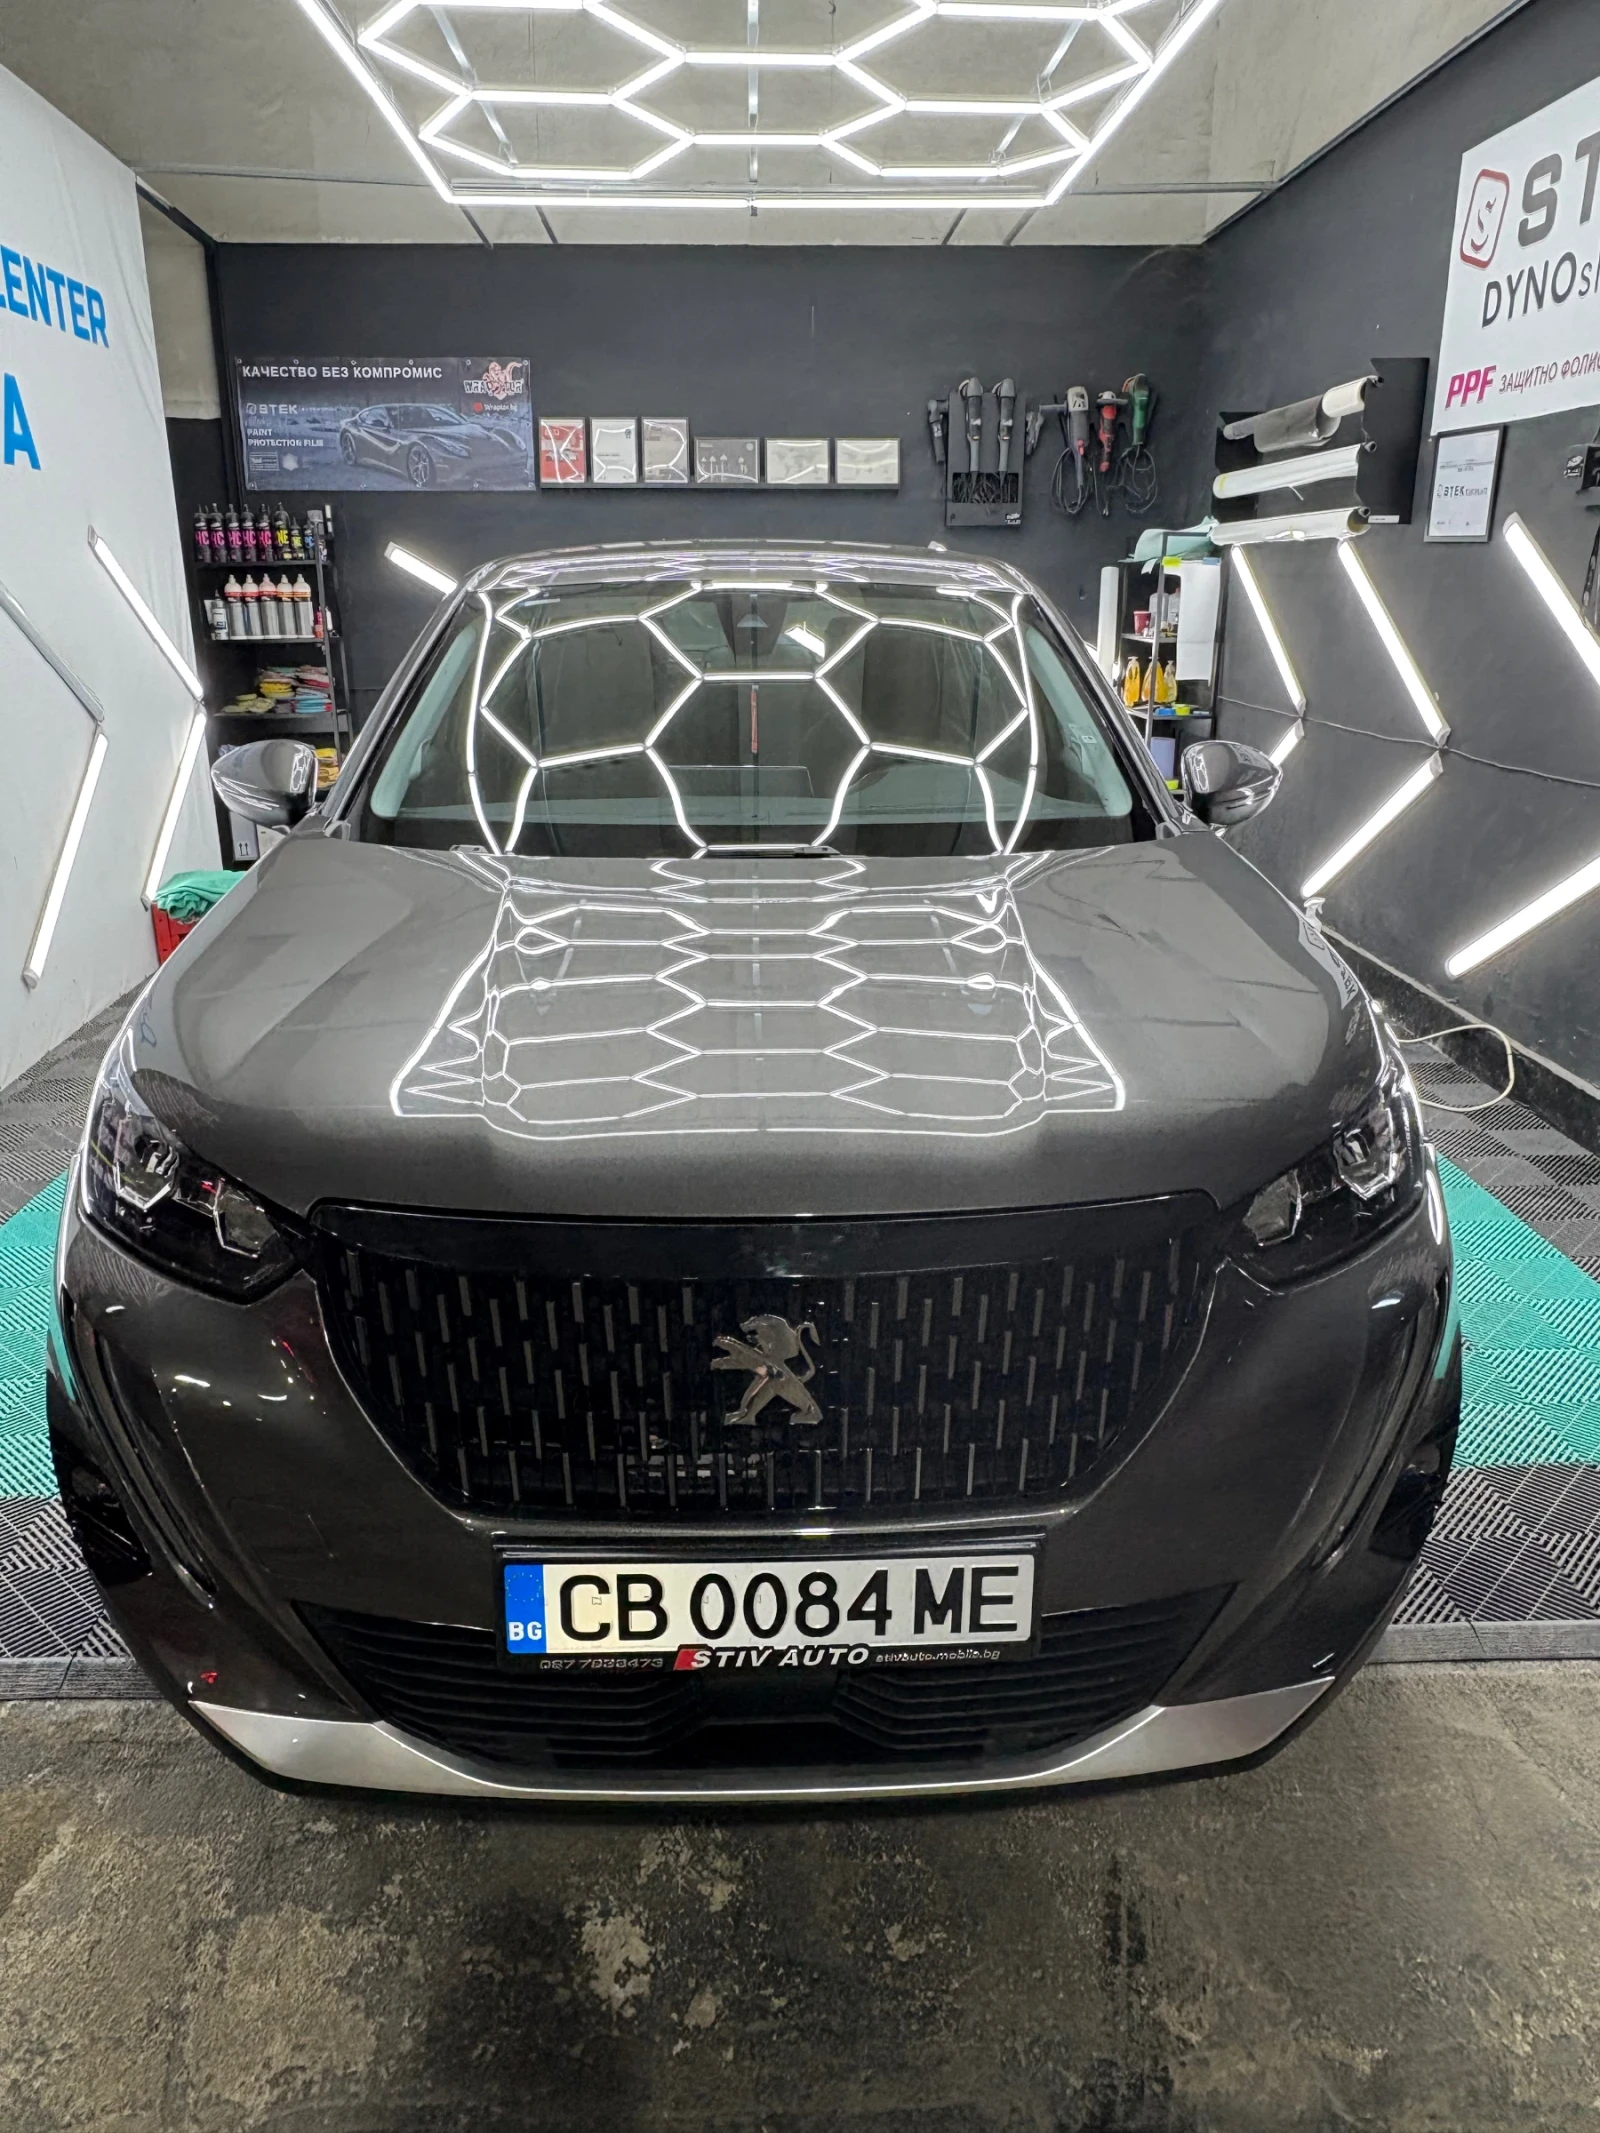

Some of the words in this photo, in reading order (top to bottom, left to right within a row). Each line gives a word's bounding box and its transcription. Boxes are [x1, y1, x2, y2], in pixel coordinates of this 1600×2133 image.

[0, 243, 109, 349] ENTER
[242, 365, 318, 378] КАЧЕСТВО
[322, 366, 349, 378] БЕЗ
[353, 367, 442, 379] КОМПРОМИС
[1445, 365, 1497, 410] PPF
[1499, 361, 1558, 394] ЗАЩИТНО
[259, 404, 298, 415] STEK
[247, 428, 273, 437] PAINT
[248, 438, 302, 447] PROTECTION
[303, 439, 324, 447] FILM
[558, 1572, 668, 1642] CB
[689, 1570, 893, 1641] 0084
[913, 1565, 1019, 1635] ME
[508, 1620, 543, 1642] BG
[690, 1648, 773, 1668] STIV
[777, 1647, 870, 1667] AUTO
